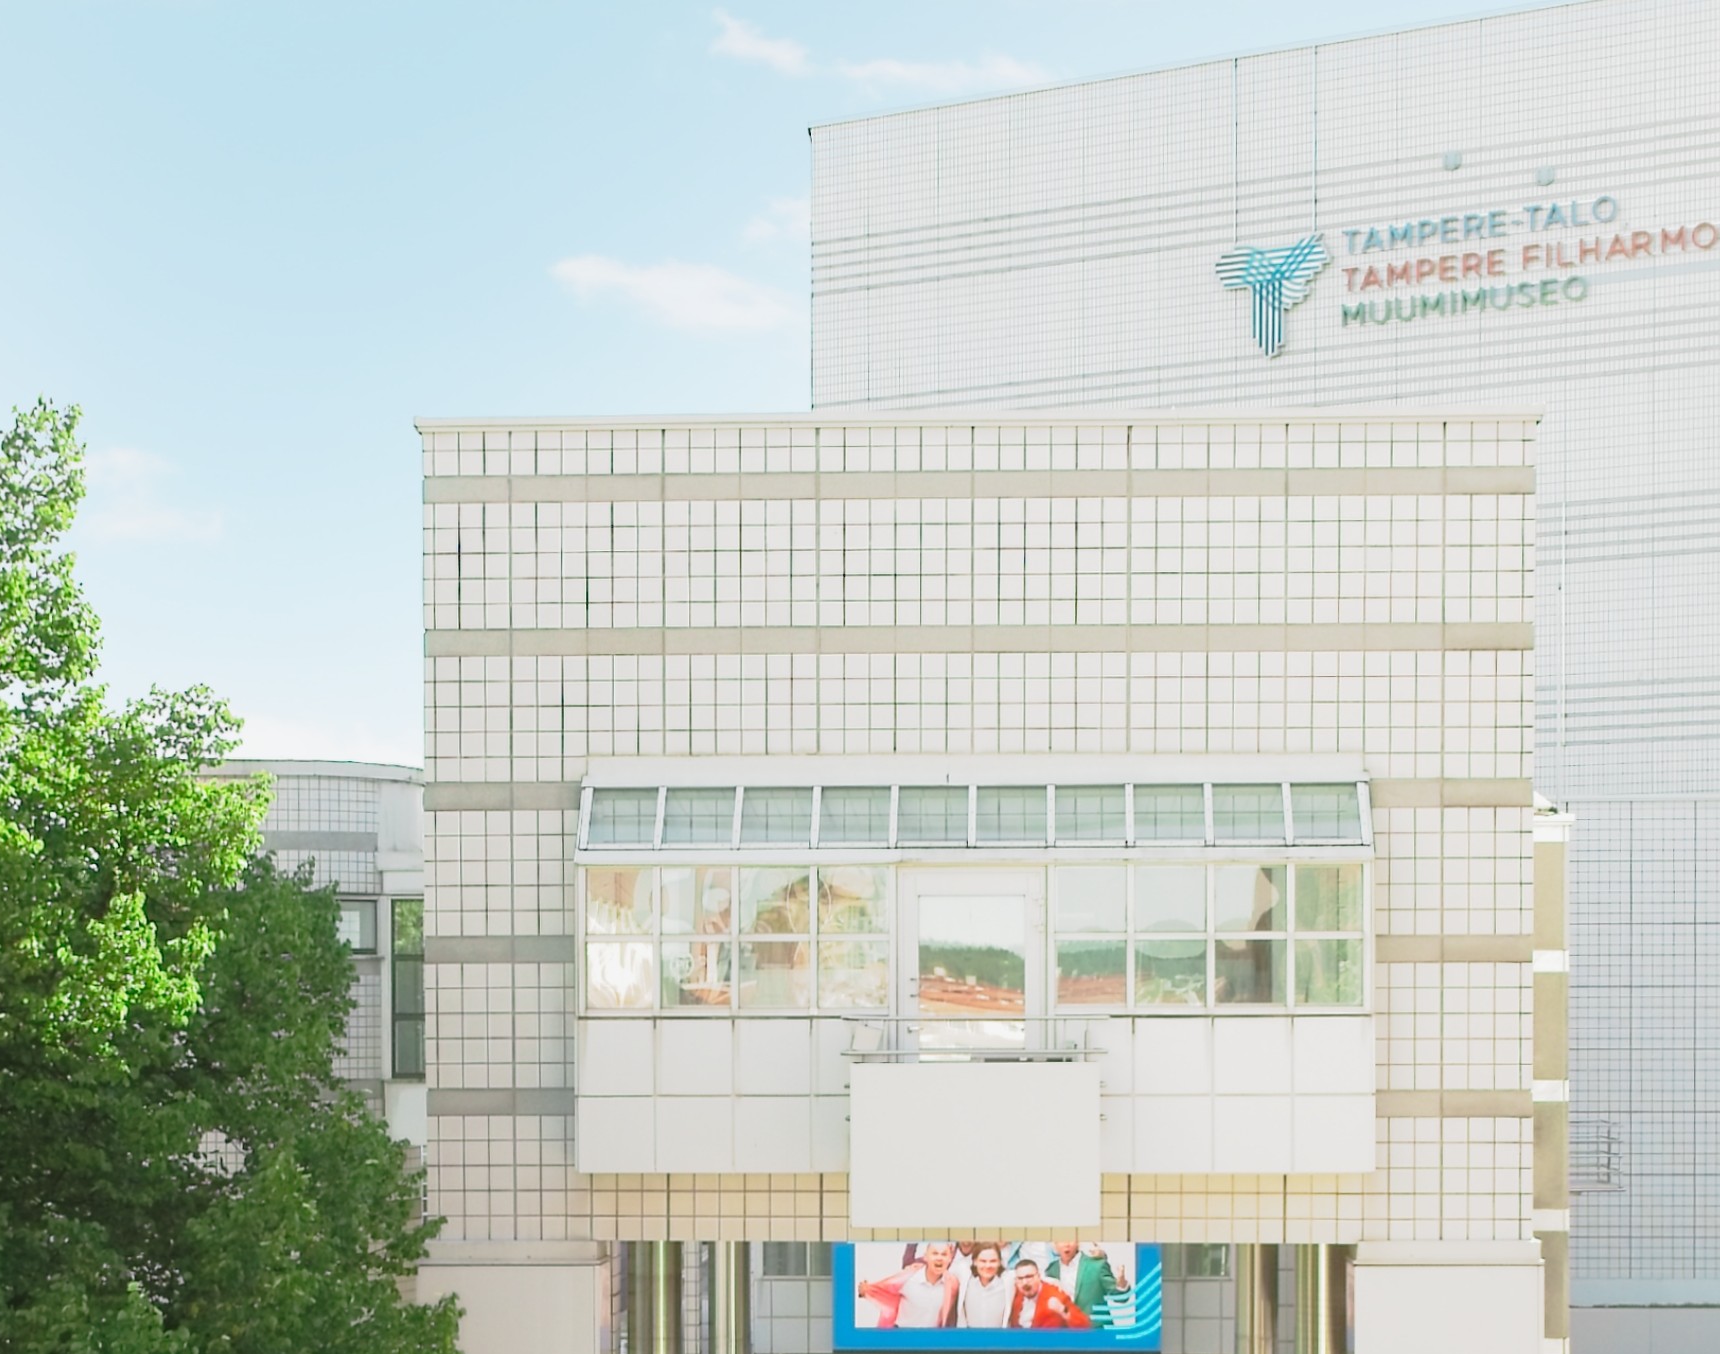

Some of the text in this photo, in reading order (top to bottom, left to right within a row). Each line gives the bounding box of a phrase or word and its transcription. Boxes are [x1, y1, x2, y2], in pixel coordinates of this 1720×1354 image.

[1342, 196, 1617, 255] TAMPERE-TALO
[1341, 246, 1507, 293] TAMPERE
[1340, 277, 1588, 327] MUUMIMUSEO
